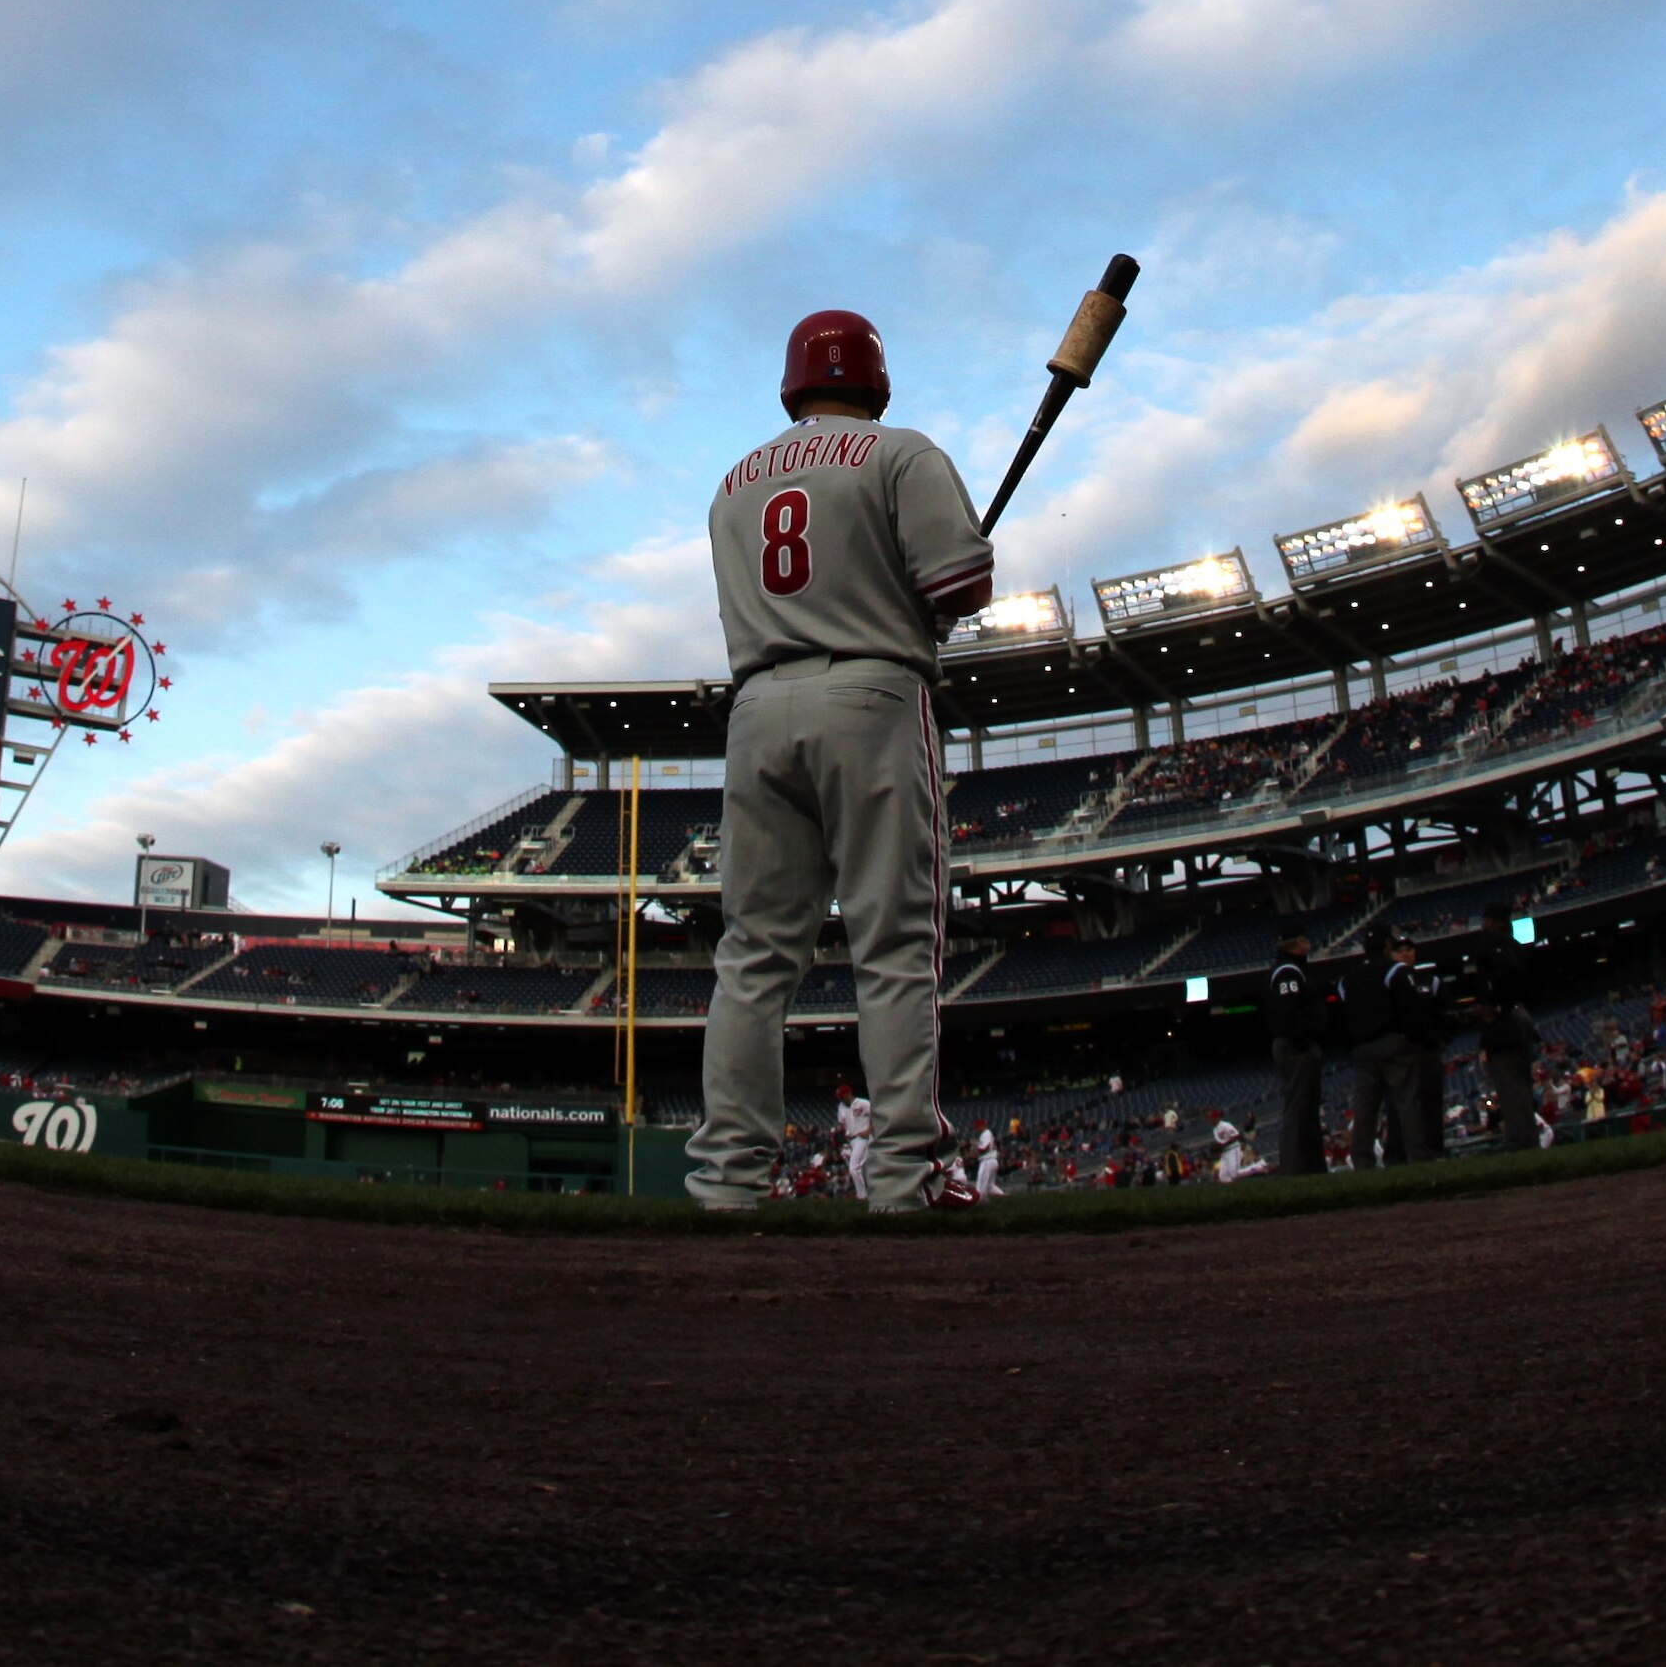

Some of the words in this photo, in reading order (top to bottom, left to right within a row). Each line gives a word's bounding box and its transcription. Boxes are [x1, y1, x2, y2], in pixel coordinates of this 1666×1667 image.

[828, 346, 841, 363] 8
[724, 432, 880, 497] VICTORINO
[760, 487, 813, 598] 8
[488, 1105, 605, 1123] nationals.com
